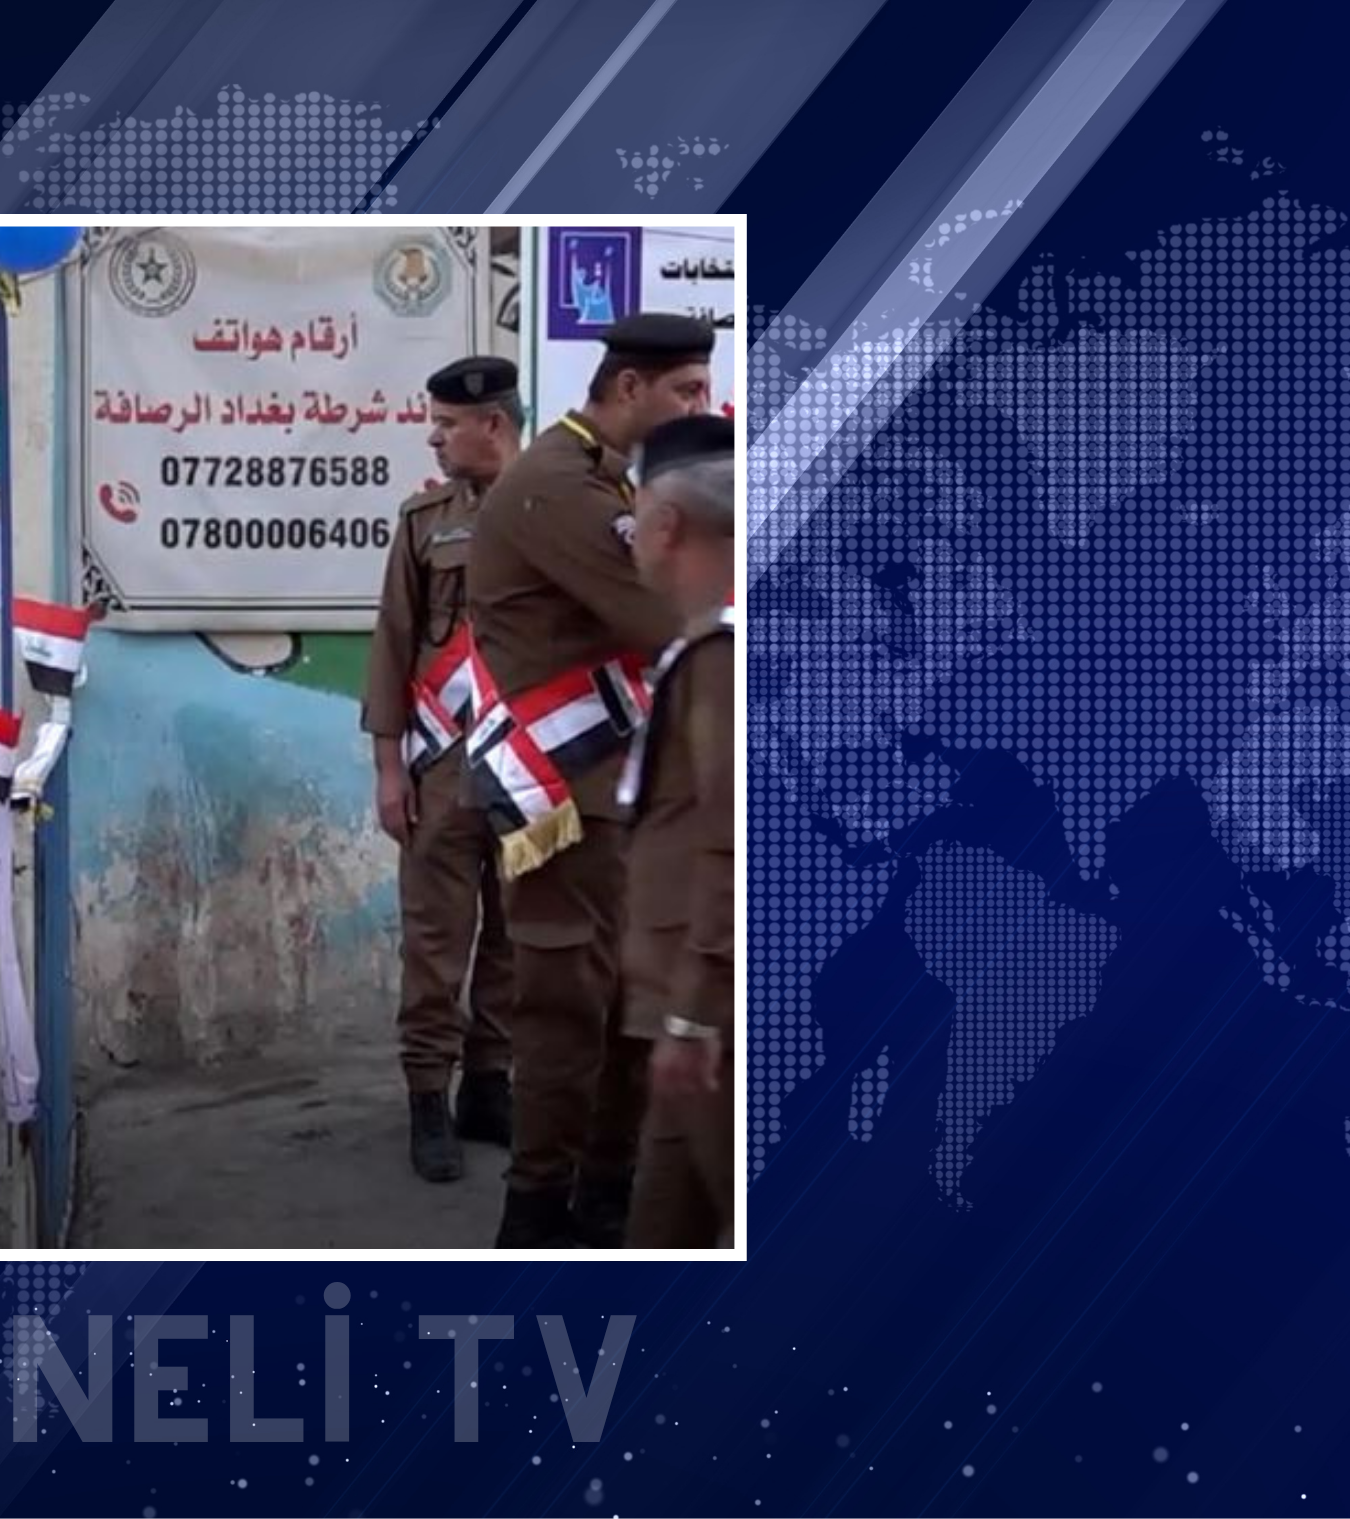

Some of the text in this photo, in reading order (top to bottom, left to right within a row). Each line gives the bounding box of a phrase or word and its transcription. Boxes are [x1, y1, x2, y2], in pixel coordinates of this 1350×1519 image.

[192, 312, 358, 363] أرقام هواتف
[94, 389, 212, 433] الرصافة
[220, 391, 295, 435] بغداد
[303, 390, 388, 434] شرطة
[161, 456, 390, 487] 07728876588
[161, 518, 390, 549] 07800006406
